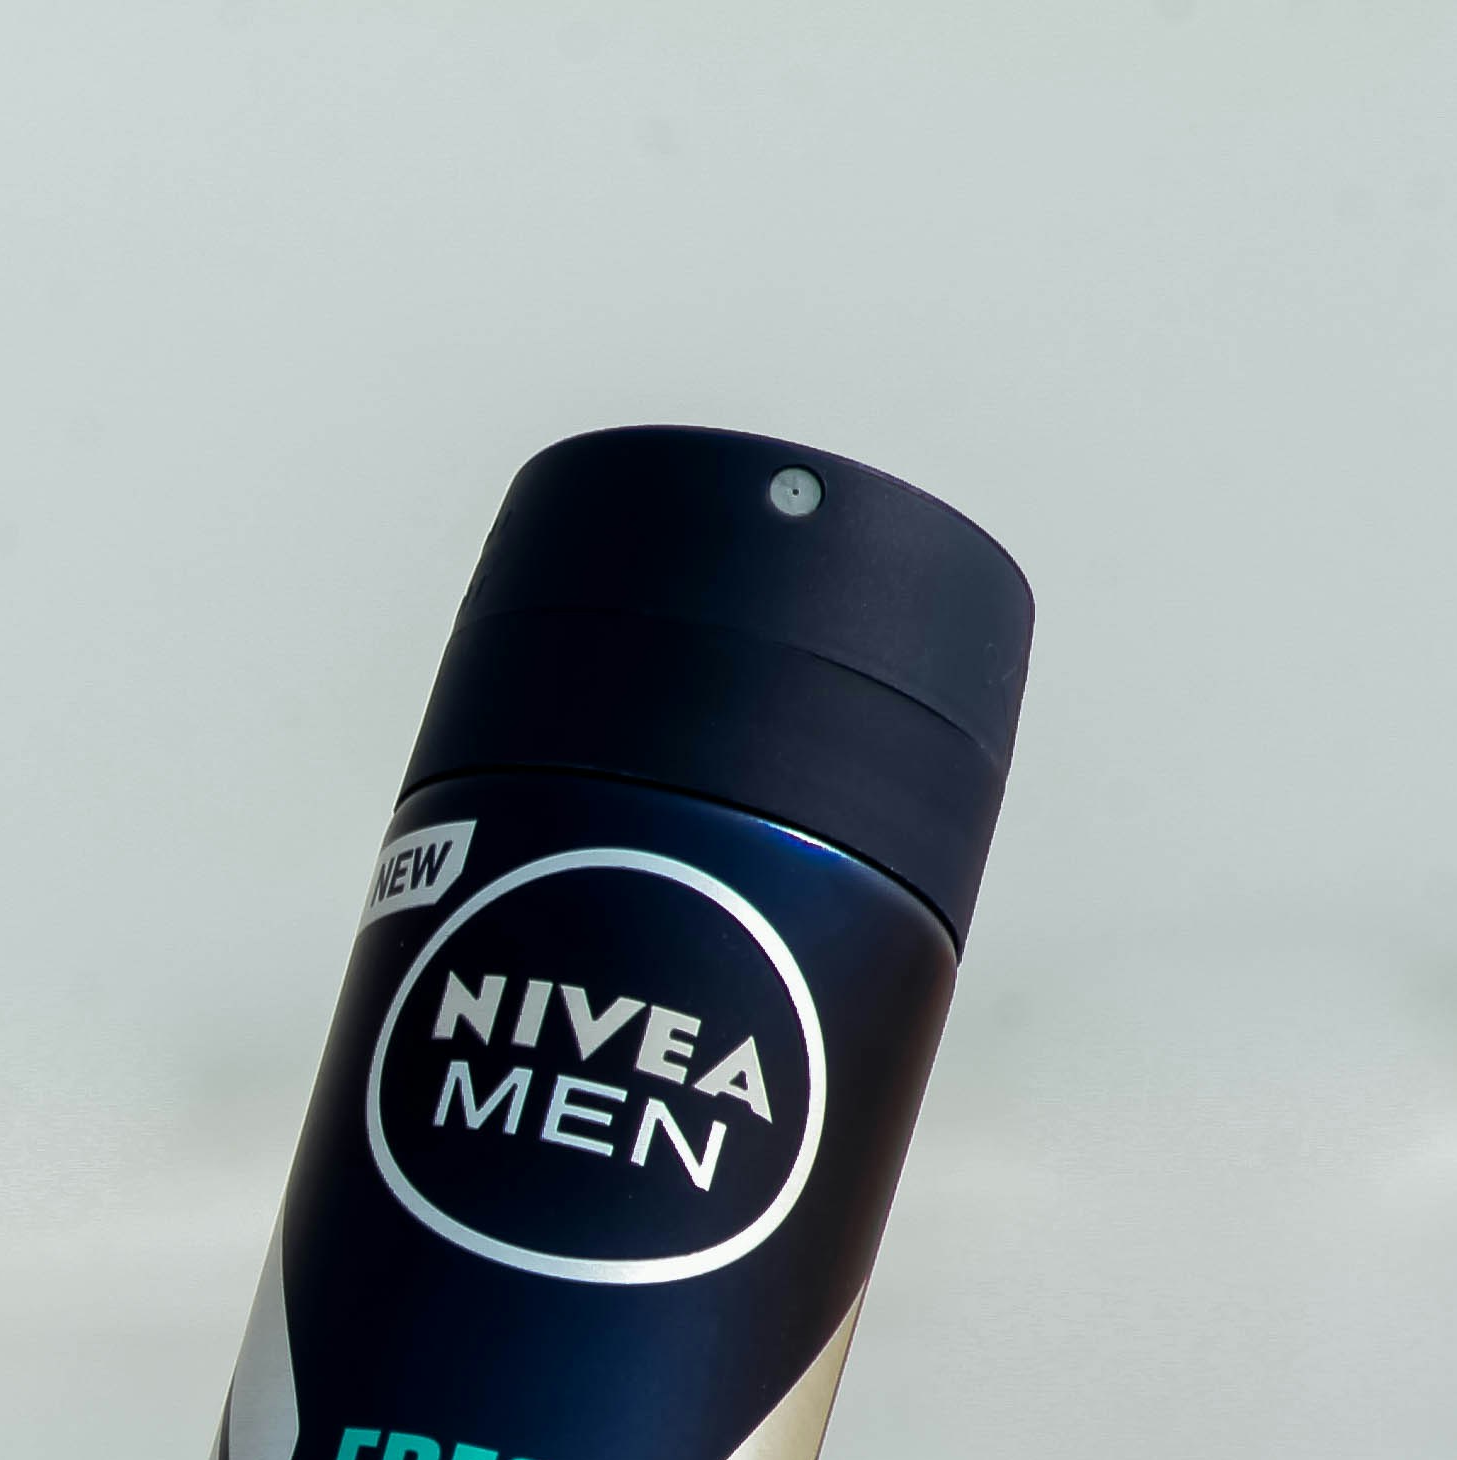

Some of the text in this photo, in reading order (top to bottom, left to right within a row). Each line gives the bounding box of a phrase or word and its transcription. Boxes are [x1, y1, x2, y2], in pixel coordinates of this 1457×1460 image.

[370, 840, 453, 908] NEW
[432, 970, 773, 1124] NIVEA
[433, 1061, 727, 1192] MEN
